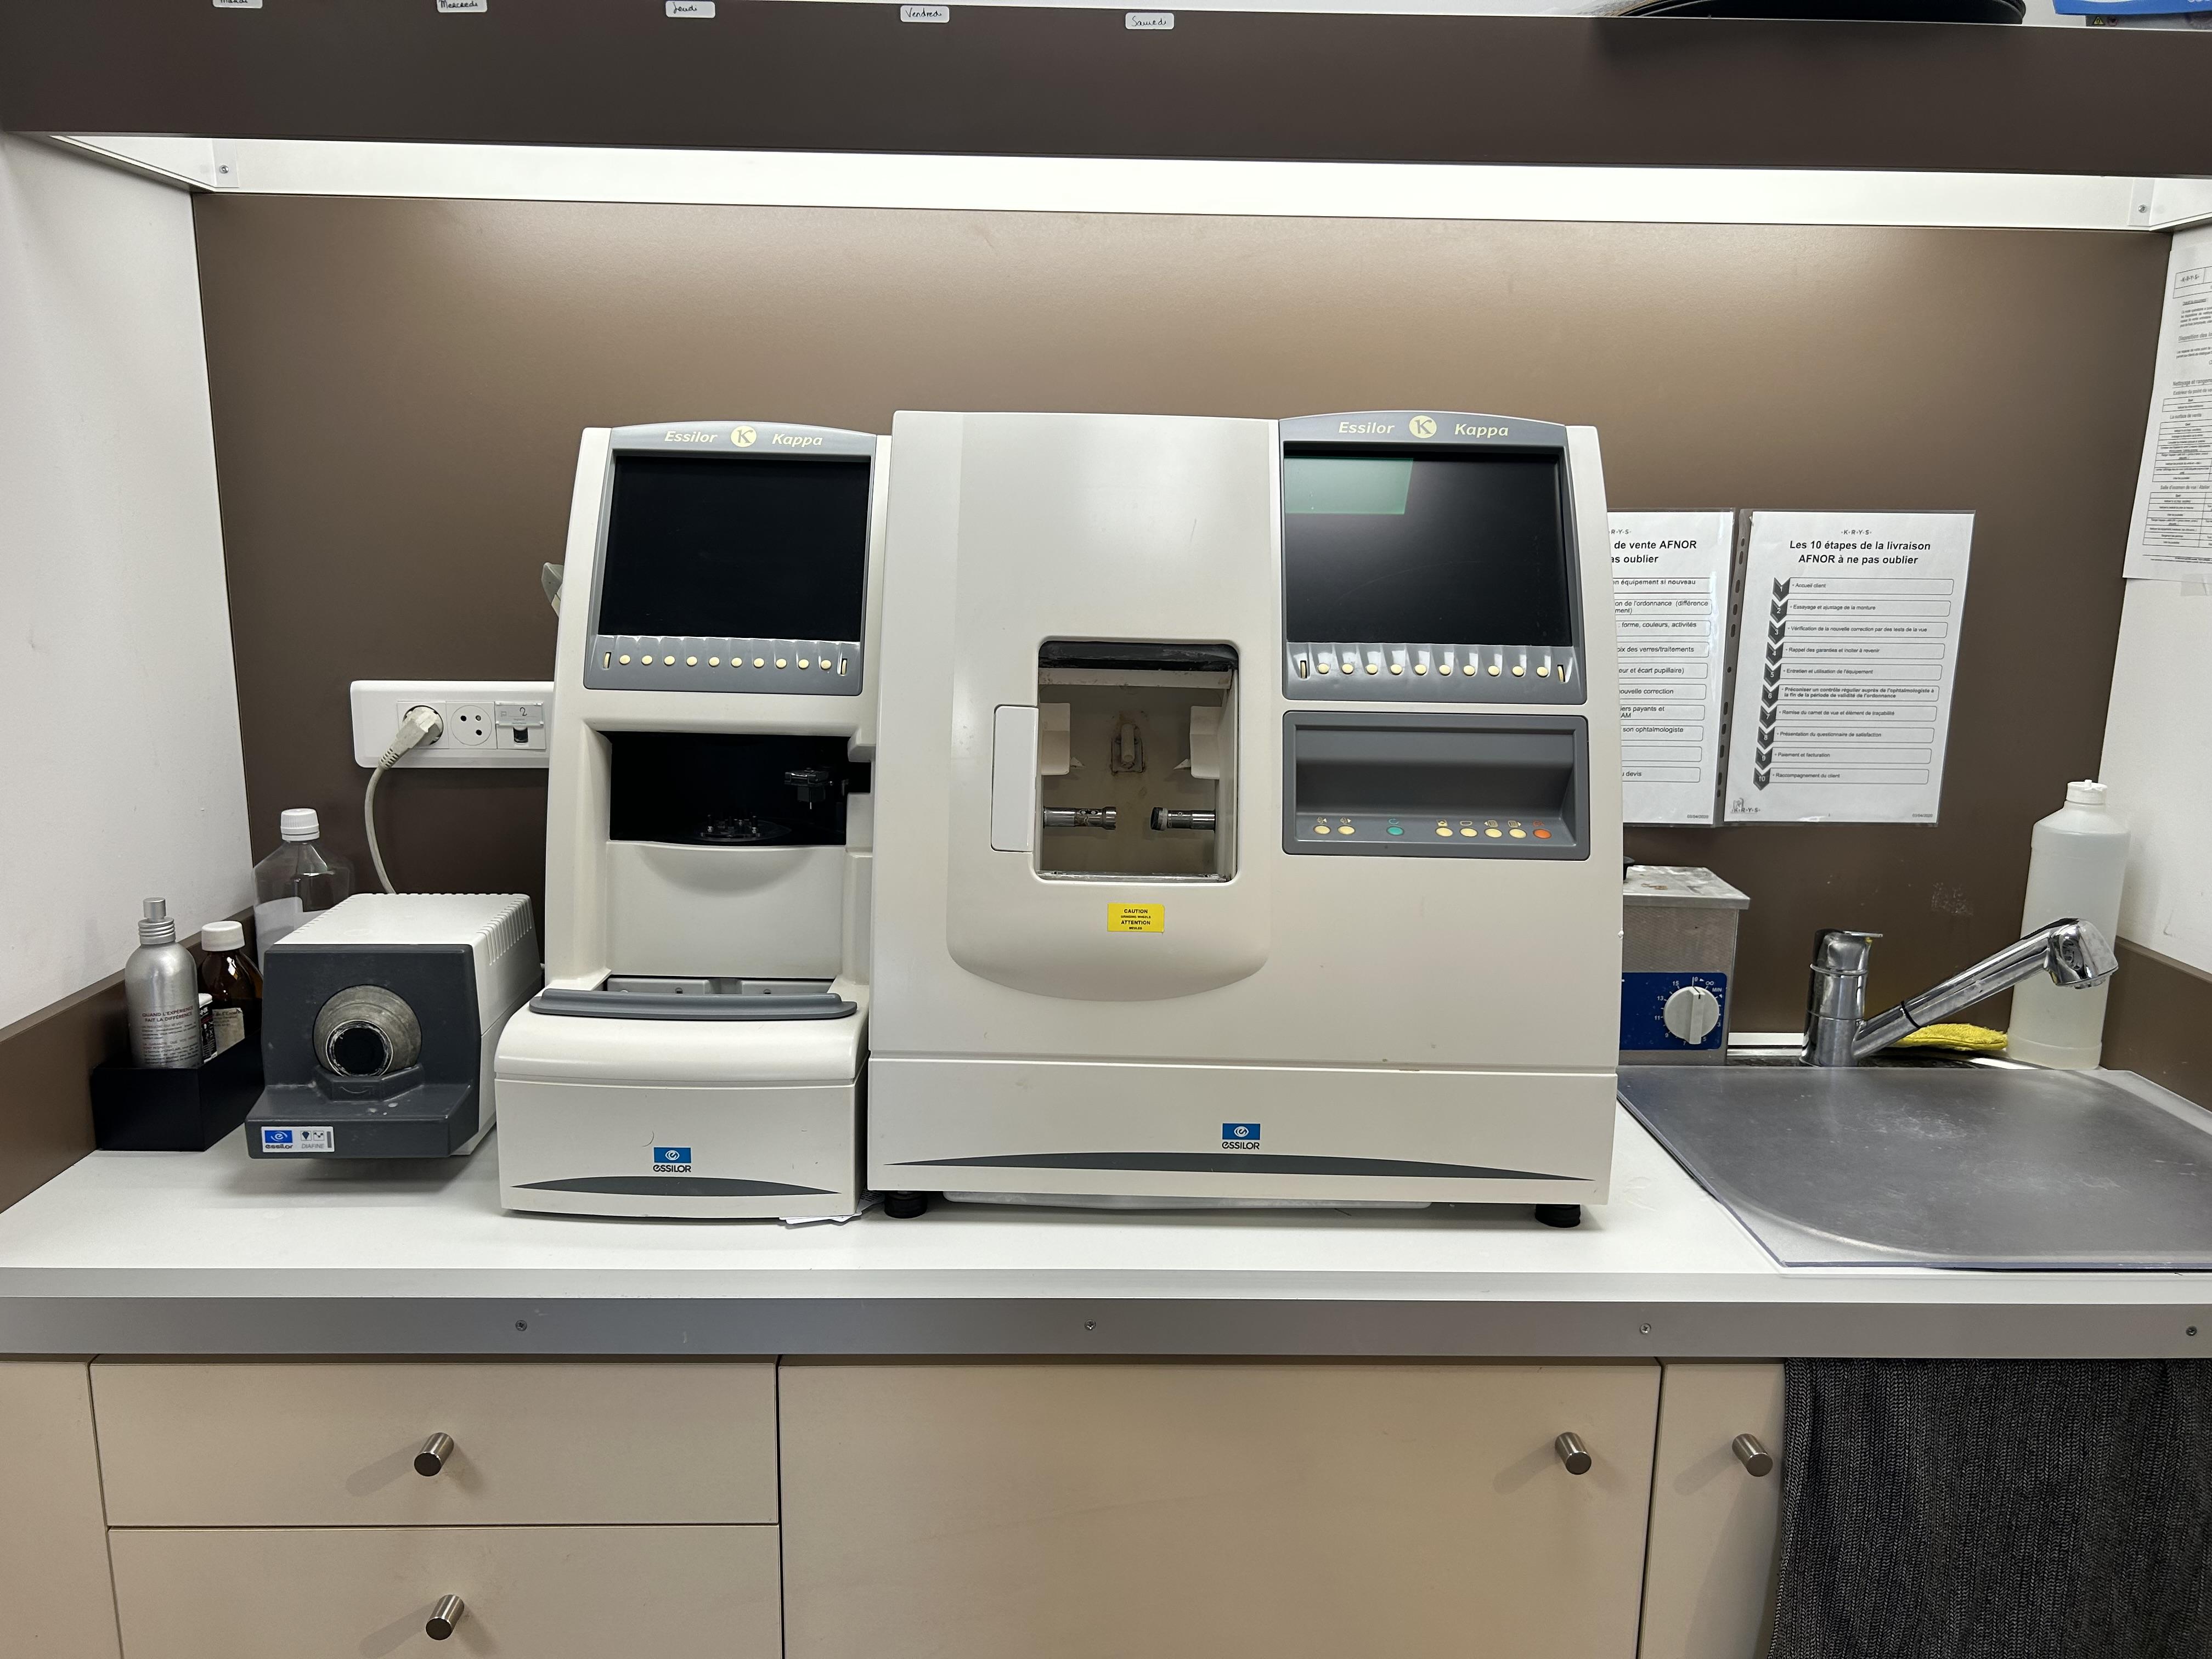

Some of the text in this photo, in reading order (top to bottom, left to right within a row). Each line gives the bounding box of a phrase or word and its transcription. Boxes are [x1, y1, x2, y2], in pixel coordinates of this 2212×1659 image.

[1338, 422, 1395, 433] Essilor
[1454, 424, 1509, 438] Kappa
[664, 431, 718, 442] Essilor
[772, 433, 823, 447] Kappa
[1614, 540, 1697, 549] de vente AFNOR
[1790, 540, 1931, 551] Les 10 étapes de la livraison
[1623, 555, 1659, 563] oublier
[1798, 555, 1835, 563] AFNOR
[1838, 555, 1844, 563] à
[1861, 556, 1880, 566] pas
[1882, 555, 1918, 564] oublier
[519, 707, 528, 716] 2
